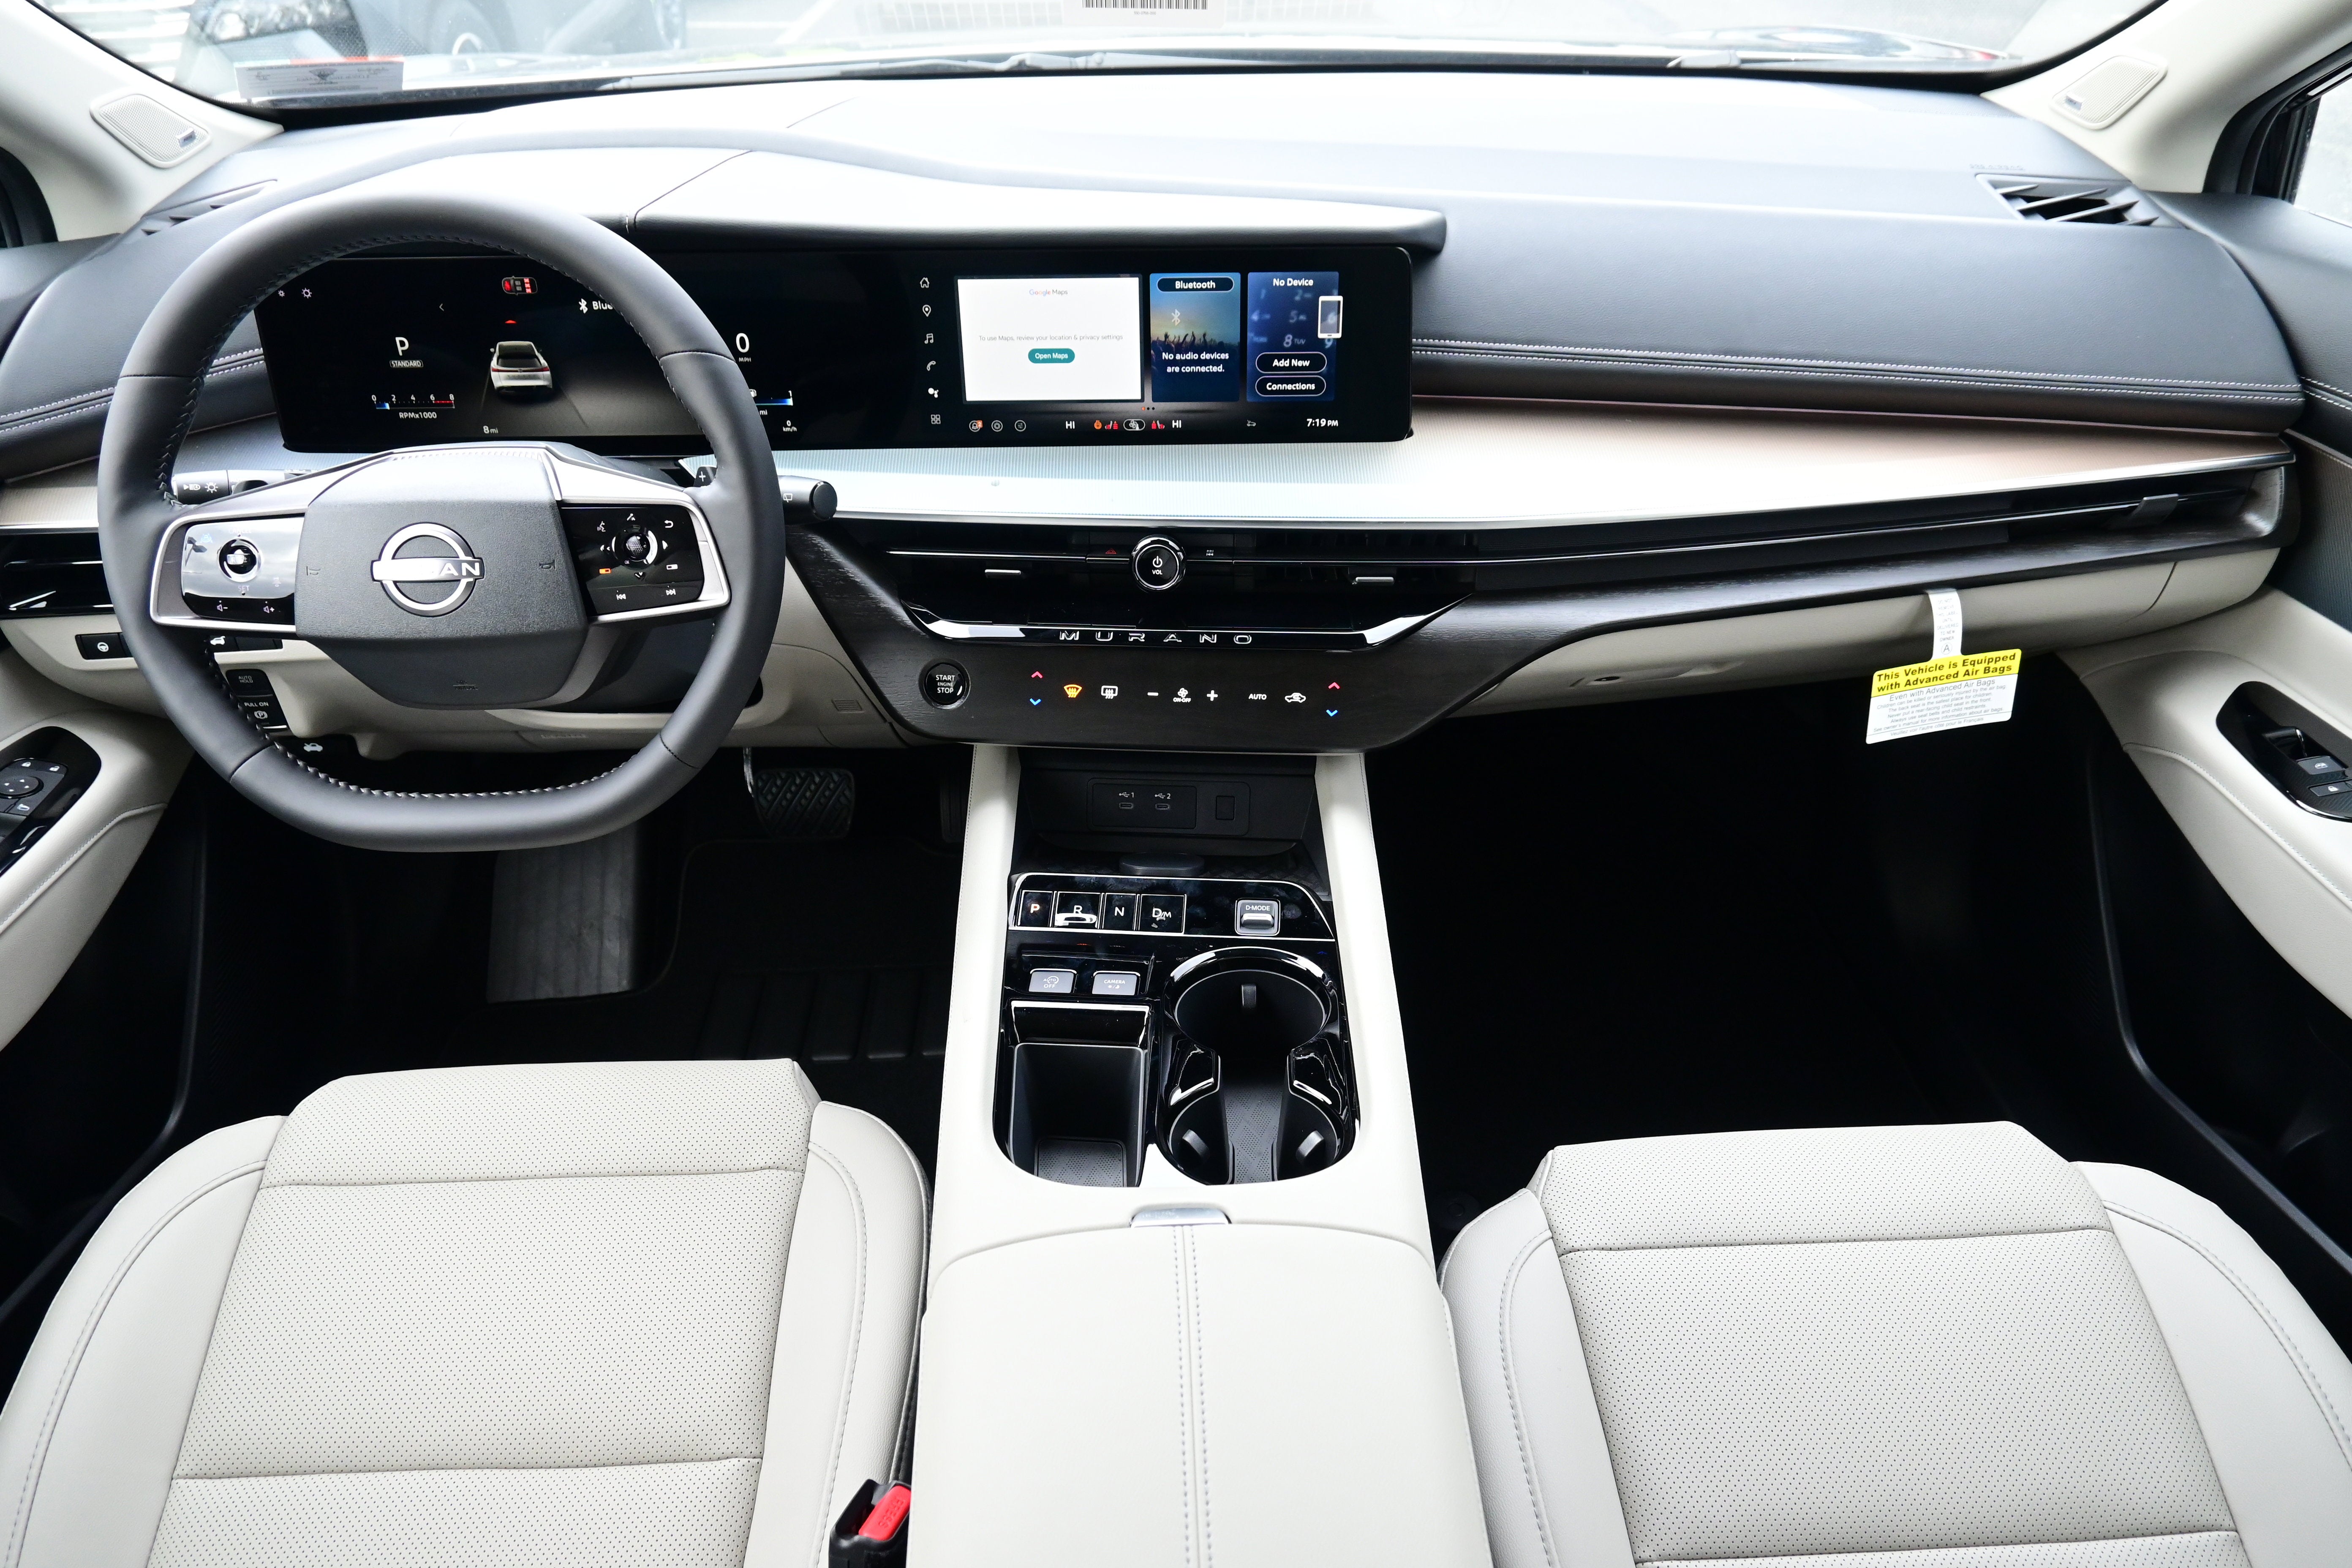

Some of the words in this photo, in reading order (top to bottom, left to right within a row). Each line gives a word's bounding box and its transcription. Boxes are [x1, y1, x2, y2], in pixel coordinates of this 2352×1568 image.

[1175, 280, 1216, 289] Bluetooth
[1287, 278, 1313, 286] Device
[736, 333, 750, 353] 0
[1283, 334, 1293, 347] 8
[395, 337, 409, 356] P
[1200, 351, 1229, 359] devices
[1272, 359, 1290, 367] Add
[1181, 364, 1225, 373] connected.
[1266, 382, 1315, 390] Connections
[1065, 421, 1075, 429] HI
[1172, 420, 1181, 428] HI
[1307, 418, 1326, 427] 7:19
[1059, 631, 1252, 644] MURANO
[1943, 644, 1950, 653] A
[1877, 672, 1900, 682] This
[1904, 664, 1944, 676] Vehicle
[1962, 653, 2016, 667] Equipped
[1877, 681, 1900, 692] with
[1904, 671, 1959, 687] Advanced
[1963, 668, 1979, 677] Air
[1983, 665, 2012, 674] Bags
[1926, 683, 1962, 694] Advanced
[1030, 904, 1040, 913] P
[1073, 905, 1083, 914] R
[1115, 907, 1124, 916] N
